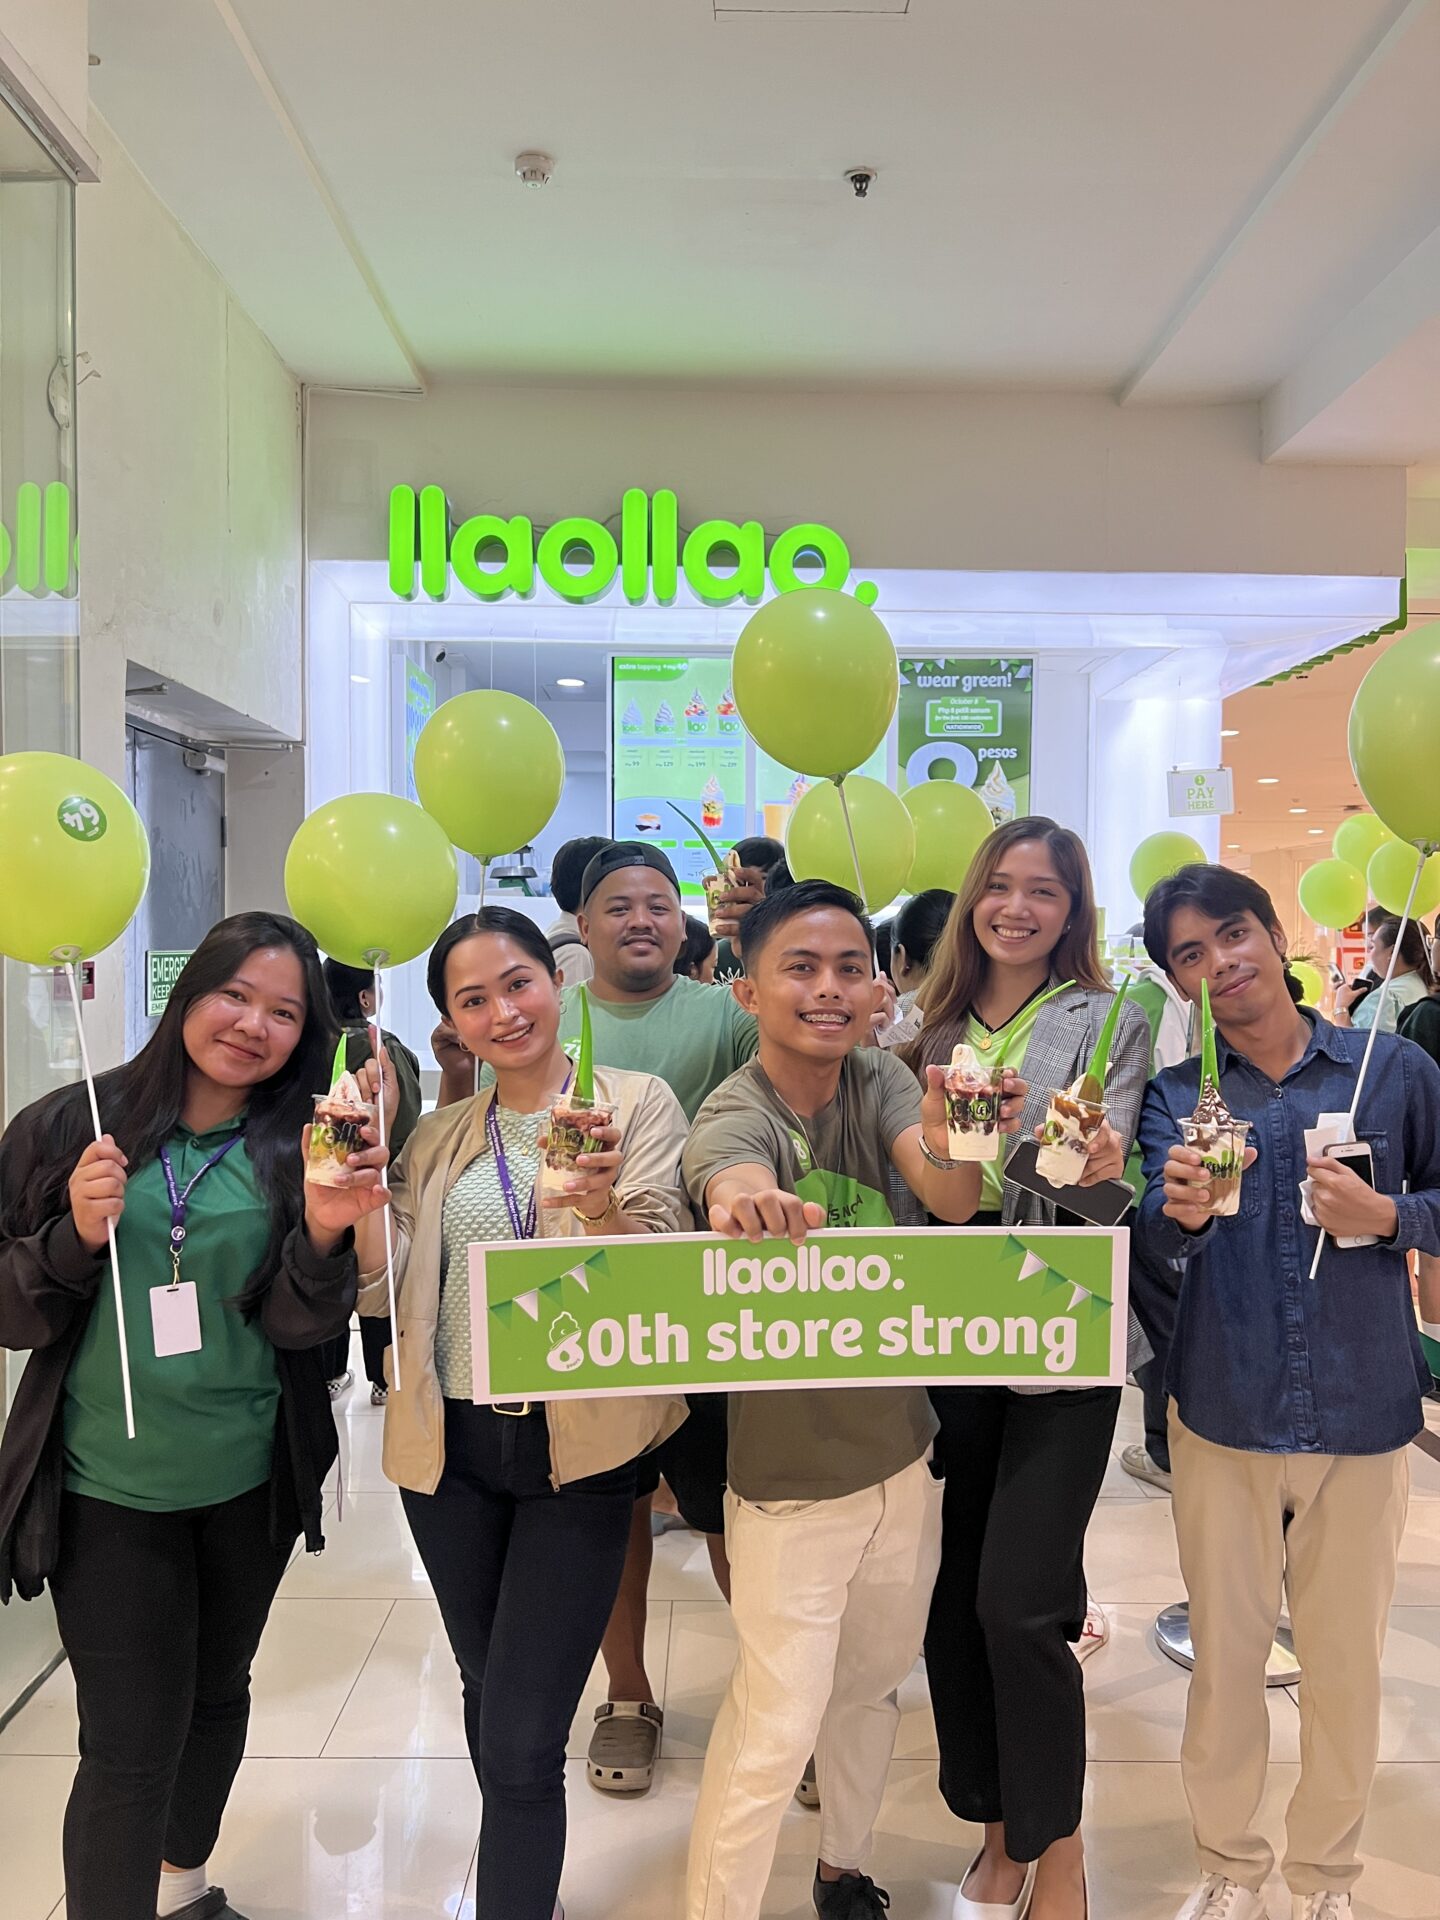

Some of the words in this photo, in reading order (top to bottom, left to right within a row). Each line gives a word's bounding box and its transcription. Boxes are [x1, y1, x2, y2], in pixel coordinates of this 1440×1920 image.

[917, 675, 960, 688] wear
[961, 671, 1012, 693] green!
[978, 747, 1018, 762] pesos
[1187, 786, 1215, 799] PAY
[1188, 801, 1215, 810] HERE
[152, 984, 171, 999] KEEP
[707, 1309, 864, 1362] store
[878, 1304, 1077, 1373] strong
